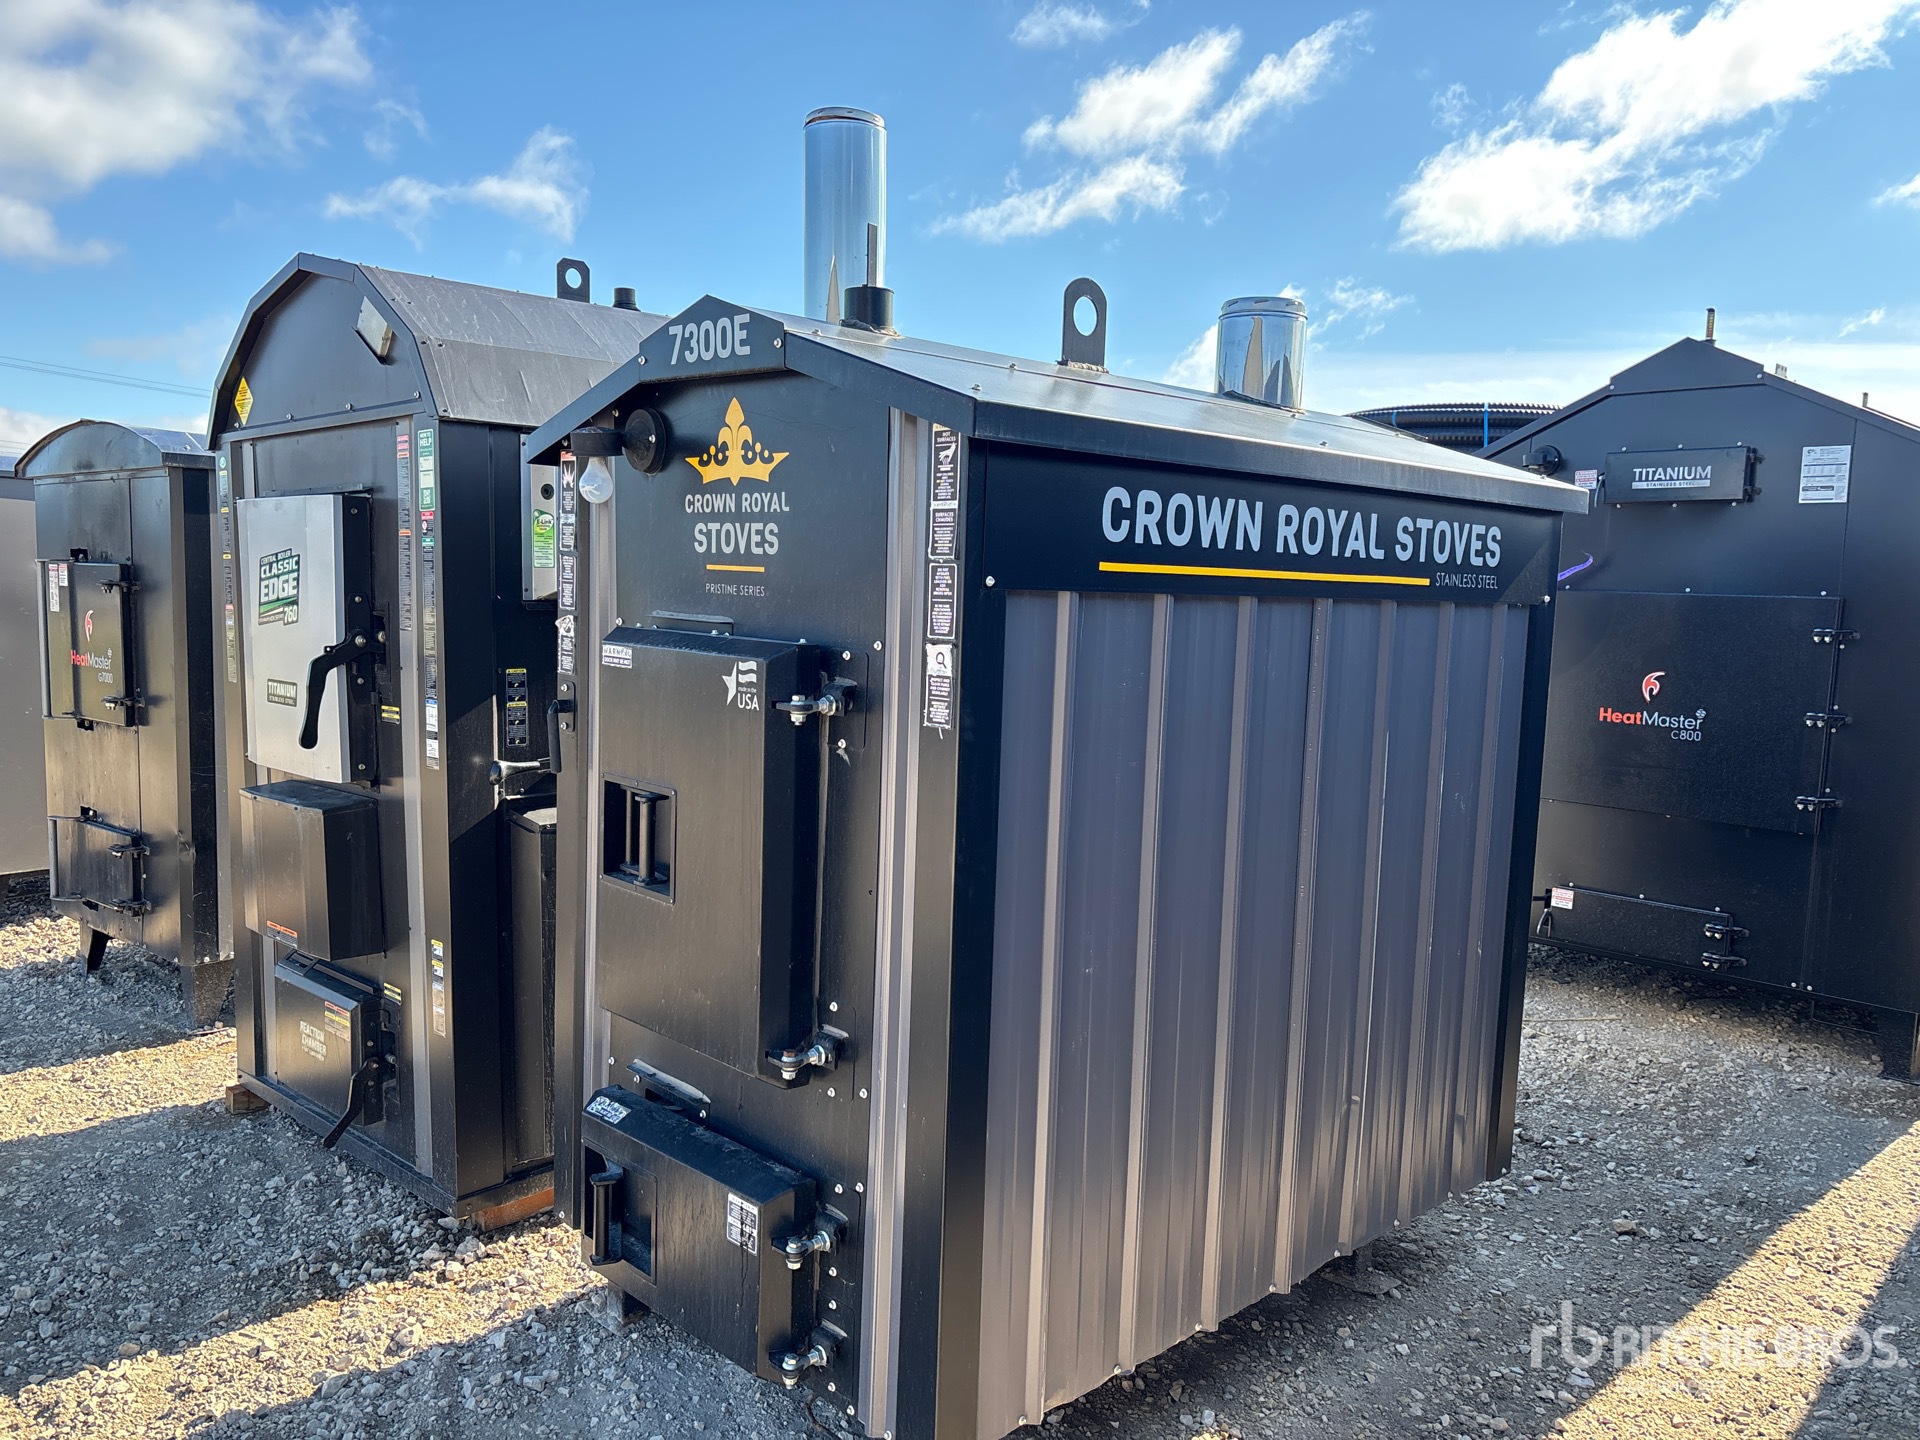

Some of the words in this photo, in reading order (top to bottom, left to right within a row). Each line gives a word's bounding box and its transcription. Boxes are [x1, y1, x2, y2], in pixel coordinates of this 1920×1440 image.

[668, 313, 750, 366] 7300E
[1632, 465, 1712, 481] TITANIUM
[685, 493, 736, 513] CROWN
[742, 491, 790, 513] ROYAL
[1102, 486, 1263, 552] CROWN
[1276, 504, 1385, 560] ROYAL
[1395, 516, 1501, 568] STOVES
[694, 522, 779, 555] STOVES
[261, 556, 298, 578] CLASSIC
[260, 572, 298, 602] EDGE
[706, 583, 738, 596] PRISTINE
[740, 584, 765, 597] SERIES
[1435, 572, 1476, 588] STAINLESS
[1477, 574, 1499, 590] STEEL
[284, 604, 298, 623] 760
[70, 650, 112, 669] HeatMaster
[268, 682, 296, 698] TITANIUM
[738, 692, 760, 711] USA
[1599, 707, 1704, 730] HeatMaster
[1670, 730, 1702, 742] C800
[299, 1020, 325, 1043] REACTION
[302, 1034, 327, 1056] CHAMBER
